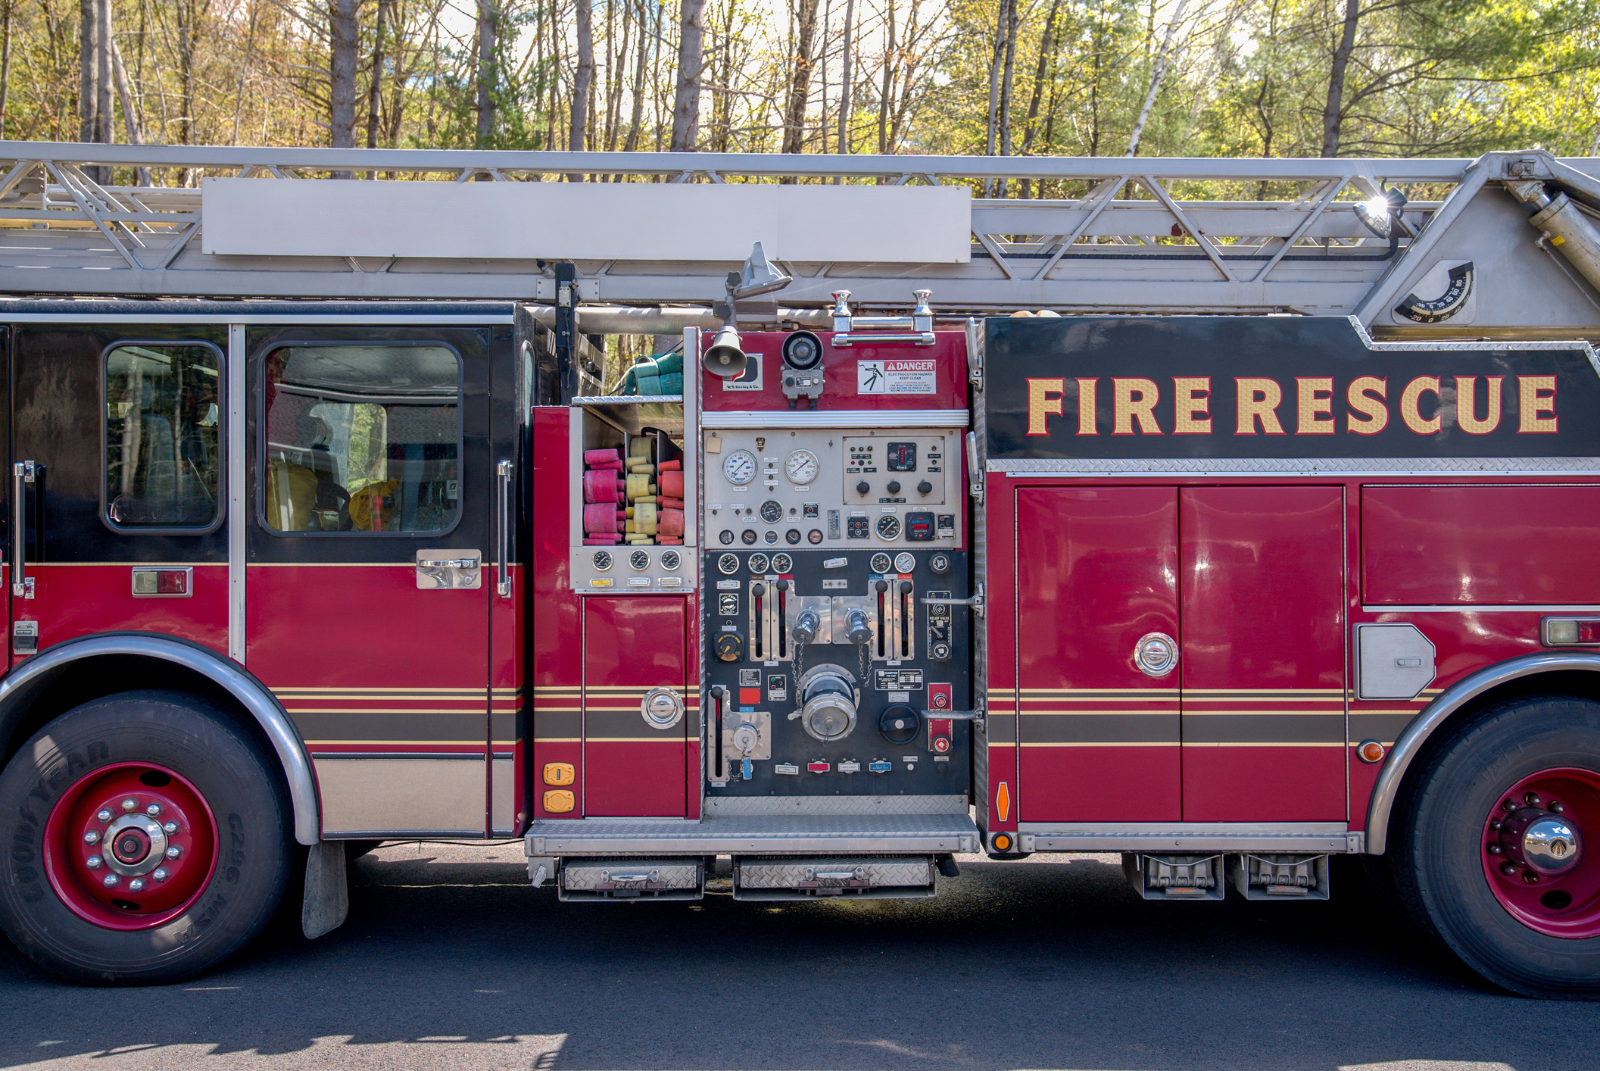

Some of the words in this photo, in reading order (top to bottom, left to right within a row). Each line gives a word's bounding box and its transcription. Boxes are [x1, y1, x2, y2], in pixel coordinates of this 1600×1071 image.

[896, 362, 932, 370] DANGER
[1025, 376, 1213, 436] FIRE
[1233, 375, 1558, 436] RESCUE
[12, 741, 109, 903] GOODYEAR
